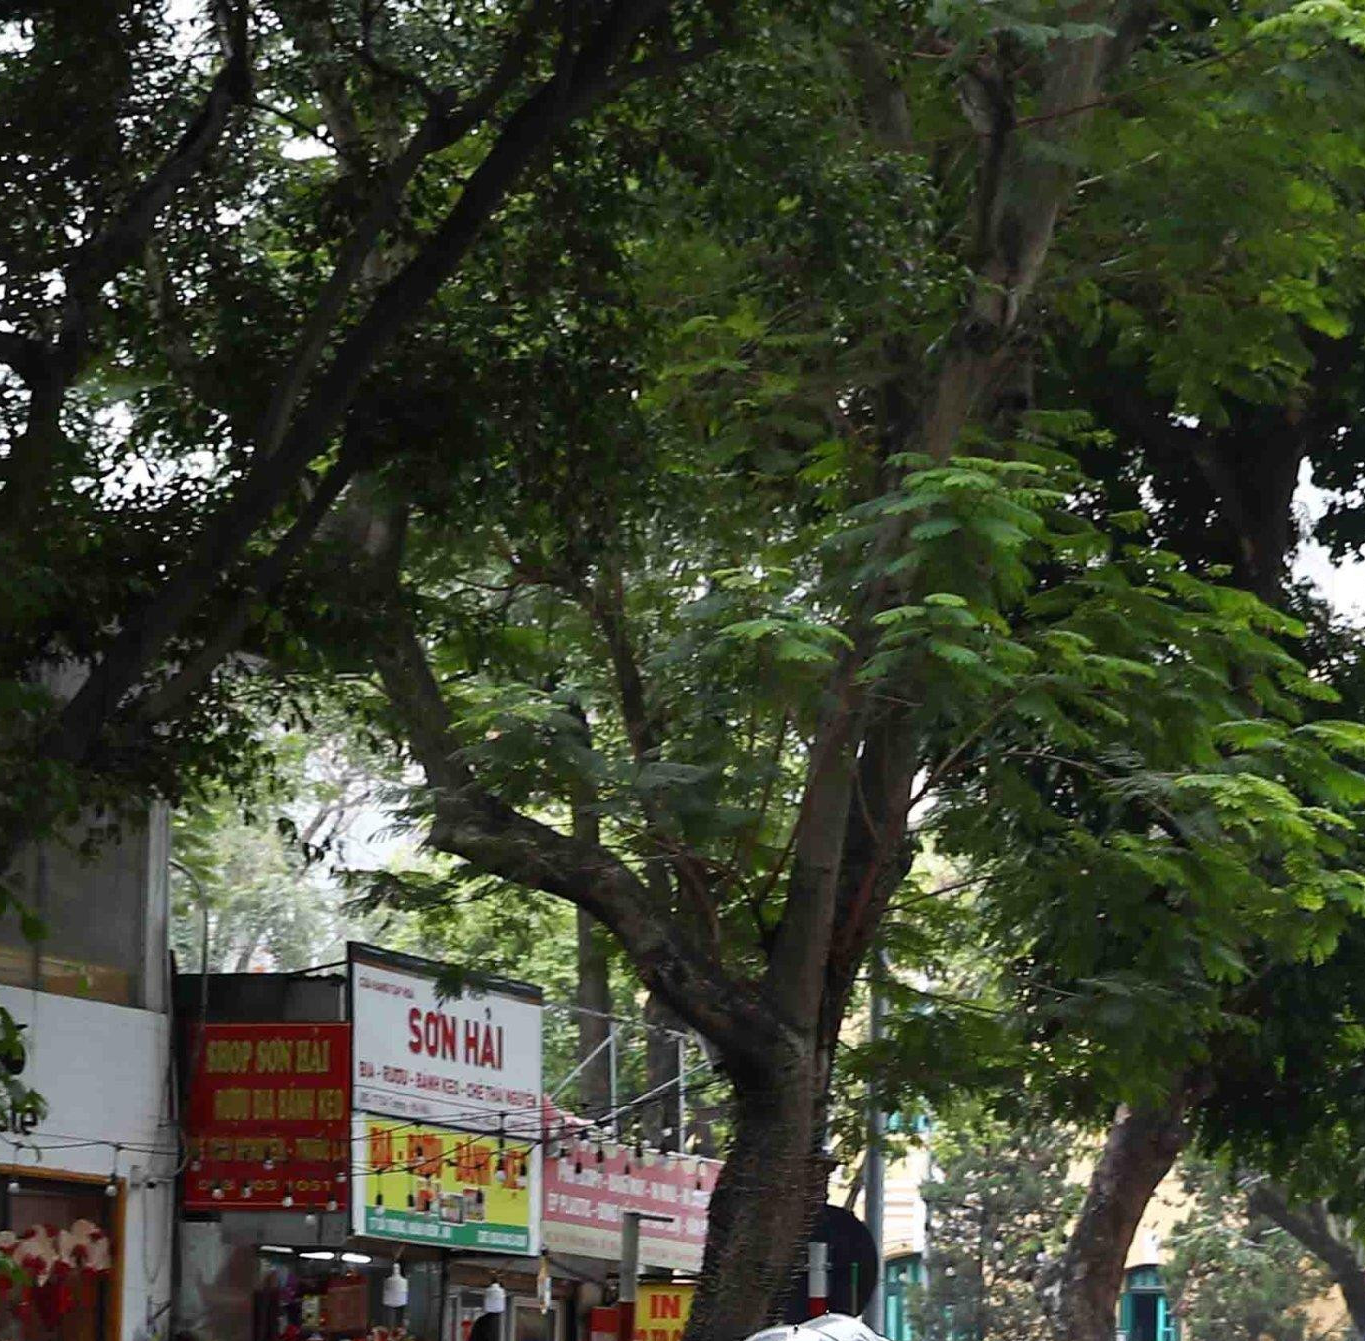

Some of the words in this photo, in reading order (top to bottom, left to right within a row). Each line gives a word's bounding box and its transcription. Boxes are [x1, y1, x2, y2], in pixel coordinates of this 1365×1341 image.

[206, 1039, 252, 1075] SHOP
[464, 1007, 504, 1072] HẢI
[650, 1294, 680, 1319] IN
